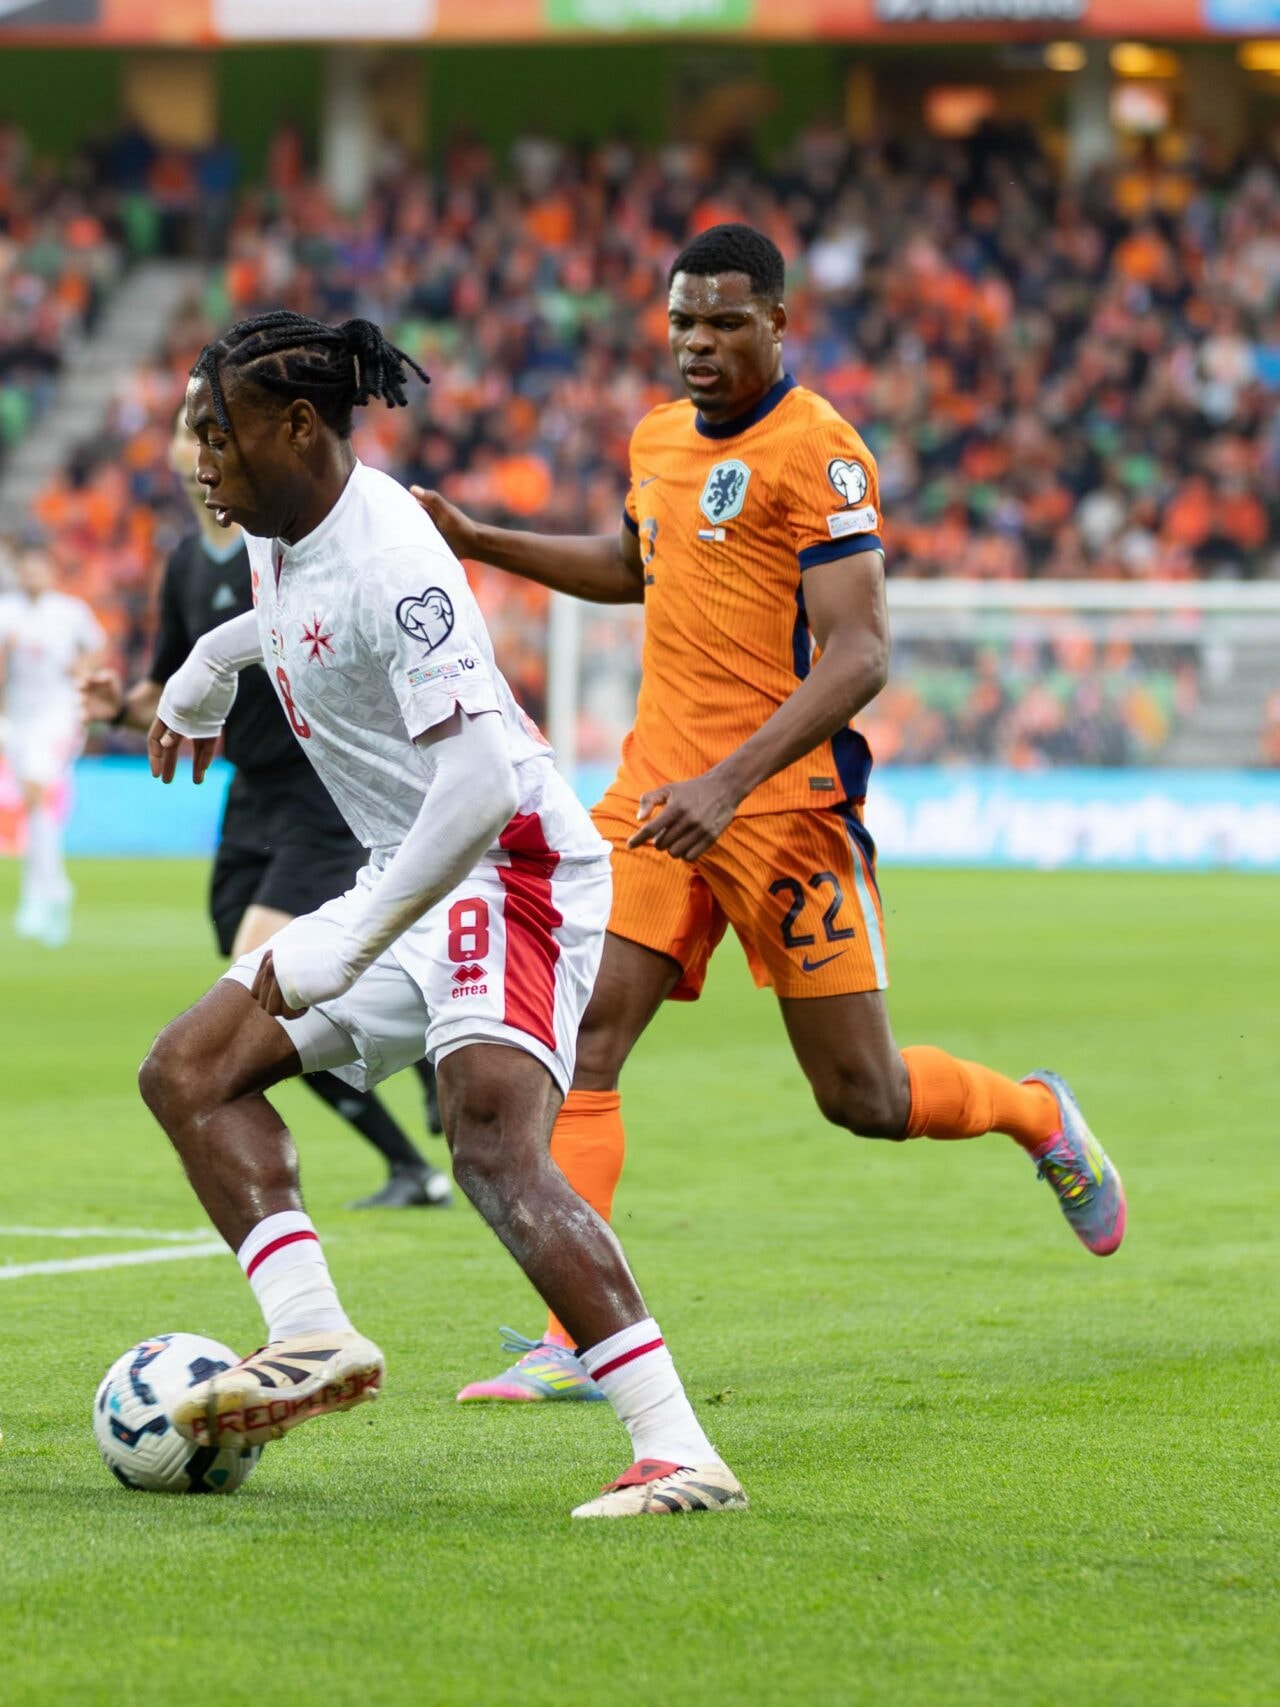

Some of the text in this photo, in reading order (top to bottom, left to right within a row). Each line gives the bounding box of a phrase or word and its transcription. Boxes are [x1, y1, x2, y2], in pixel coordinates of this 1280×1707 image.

[276, 665, 311, 739] 8
[448, 897, 489, 963] 8
[768, 871, 855, 949] 22
